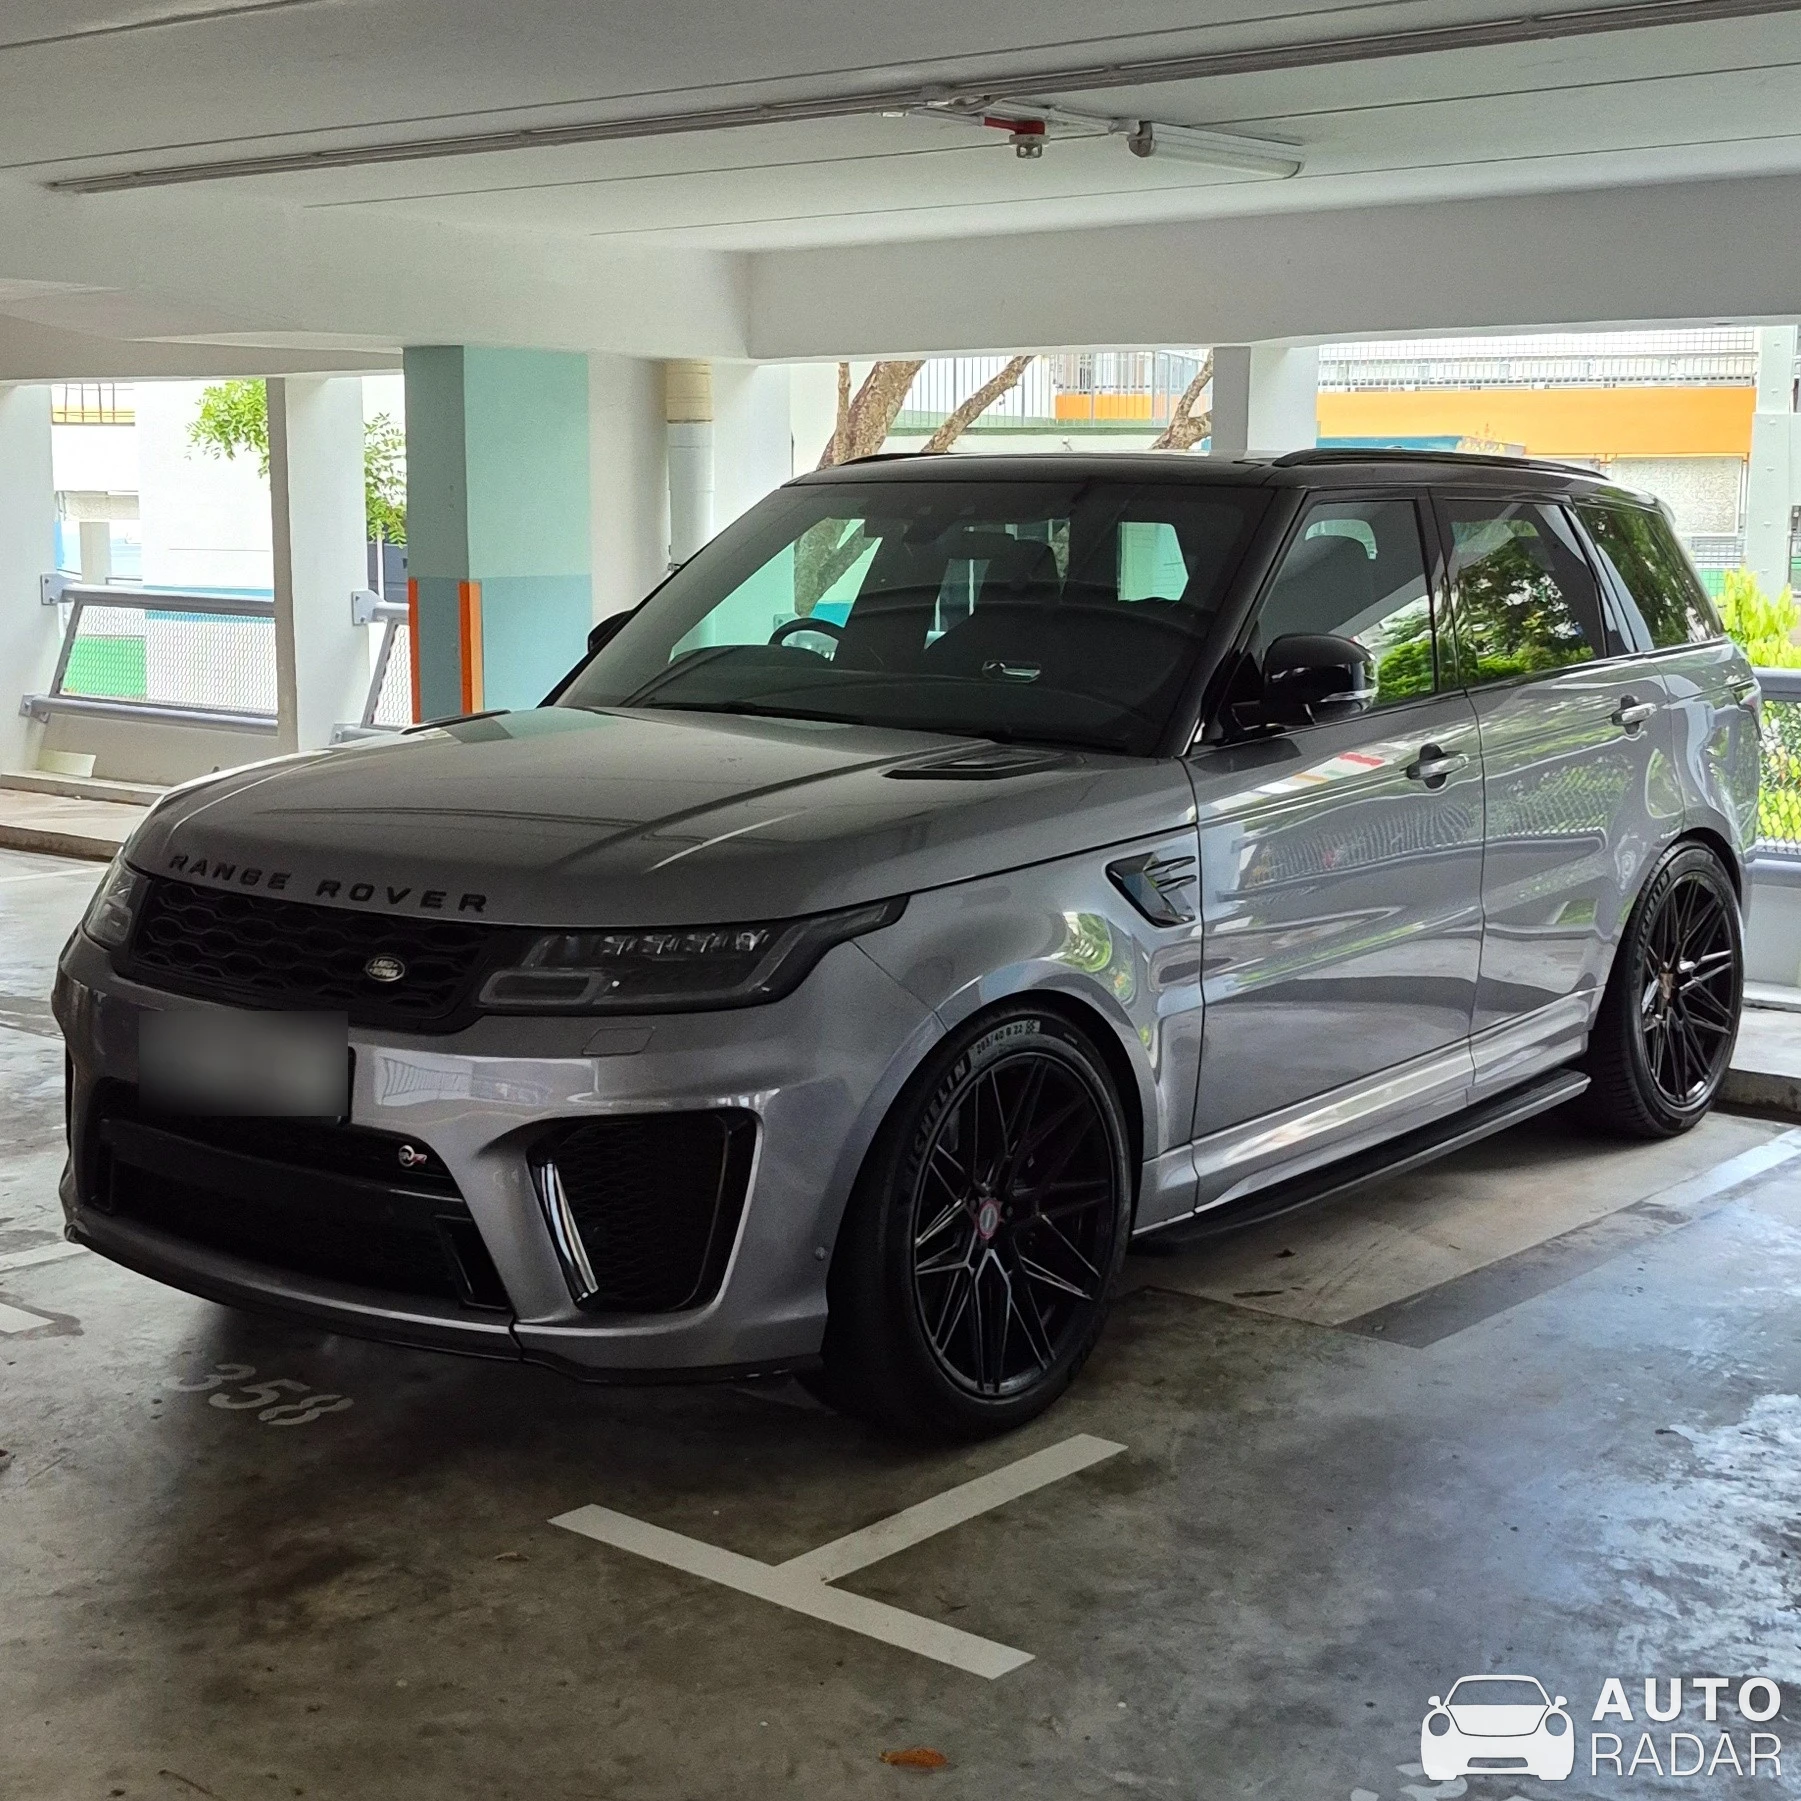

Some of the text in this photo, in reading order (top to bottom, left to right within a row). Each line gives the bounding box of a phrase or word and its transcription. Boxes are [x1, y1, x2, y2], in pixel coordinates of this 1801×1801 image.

[168, 855, 487, 913] RANGE ROVER
[161, 1363, 354, 1425] 358
